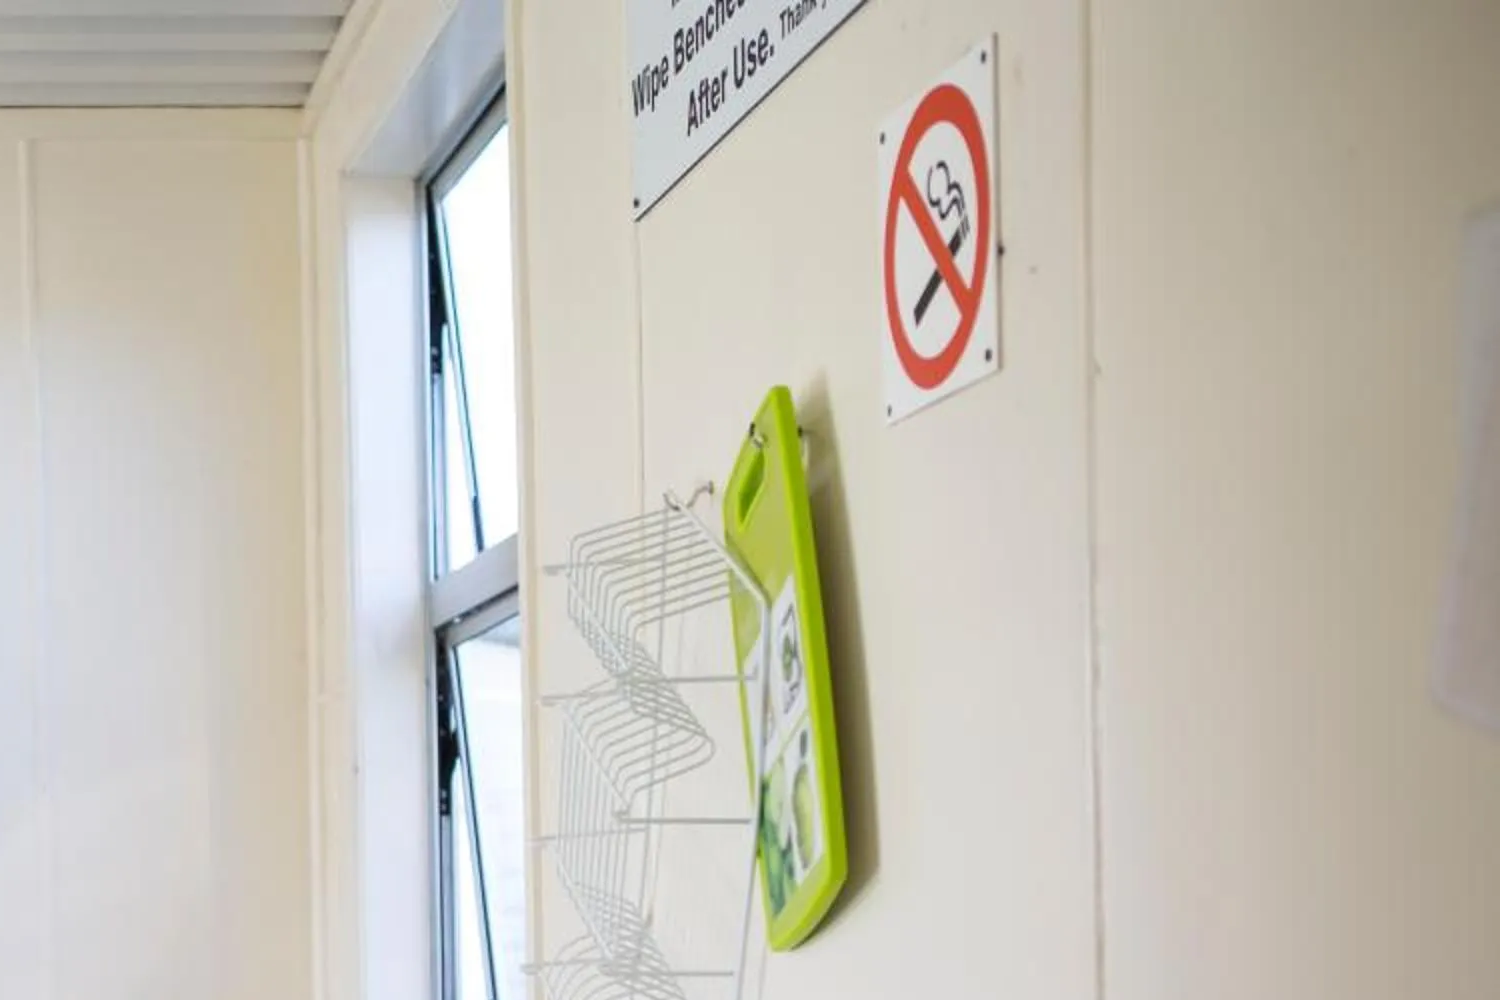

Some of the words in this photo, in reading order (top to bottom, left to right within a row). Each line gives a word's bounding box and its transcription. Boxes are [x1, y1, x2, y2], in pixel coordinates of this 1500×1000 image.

[631, 55, 670, 117] Wipe
[672, 0, 746, 76] Benche
[687, 67, 729, 138] After
[733, 27, 776, 90] Use.
